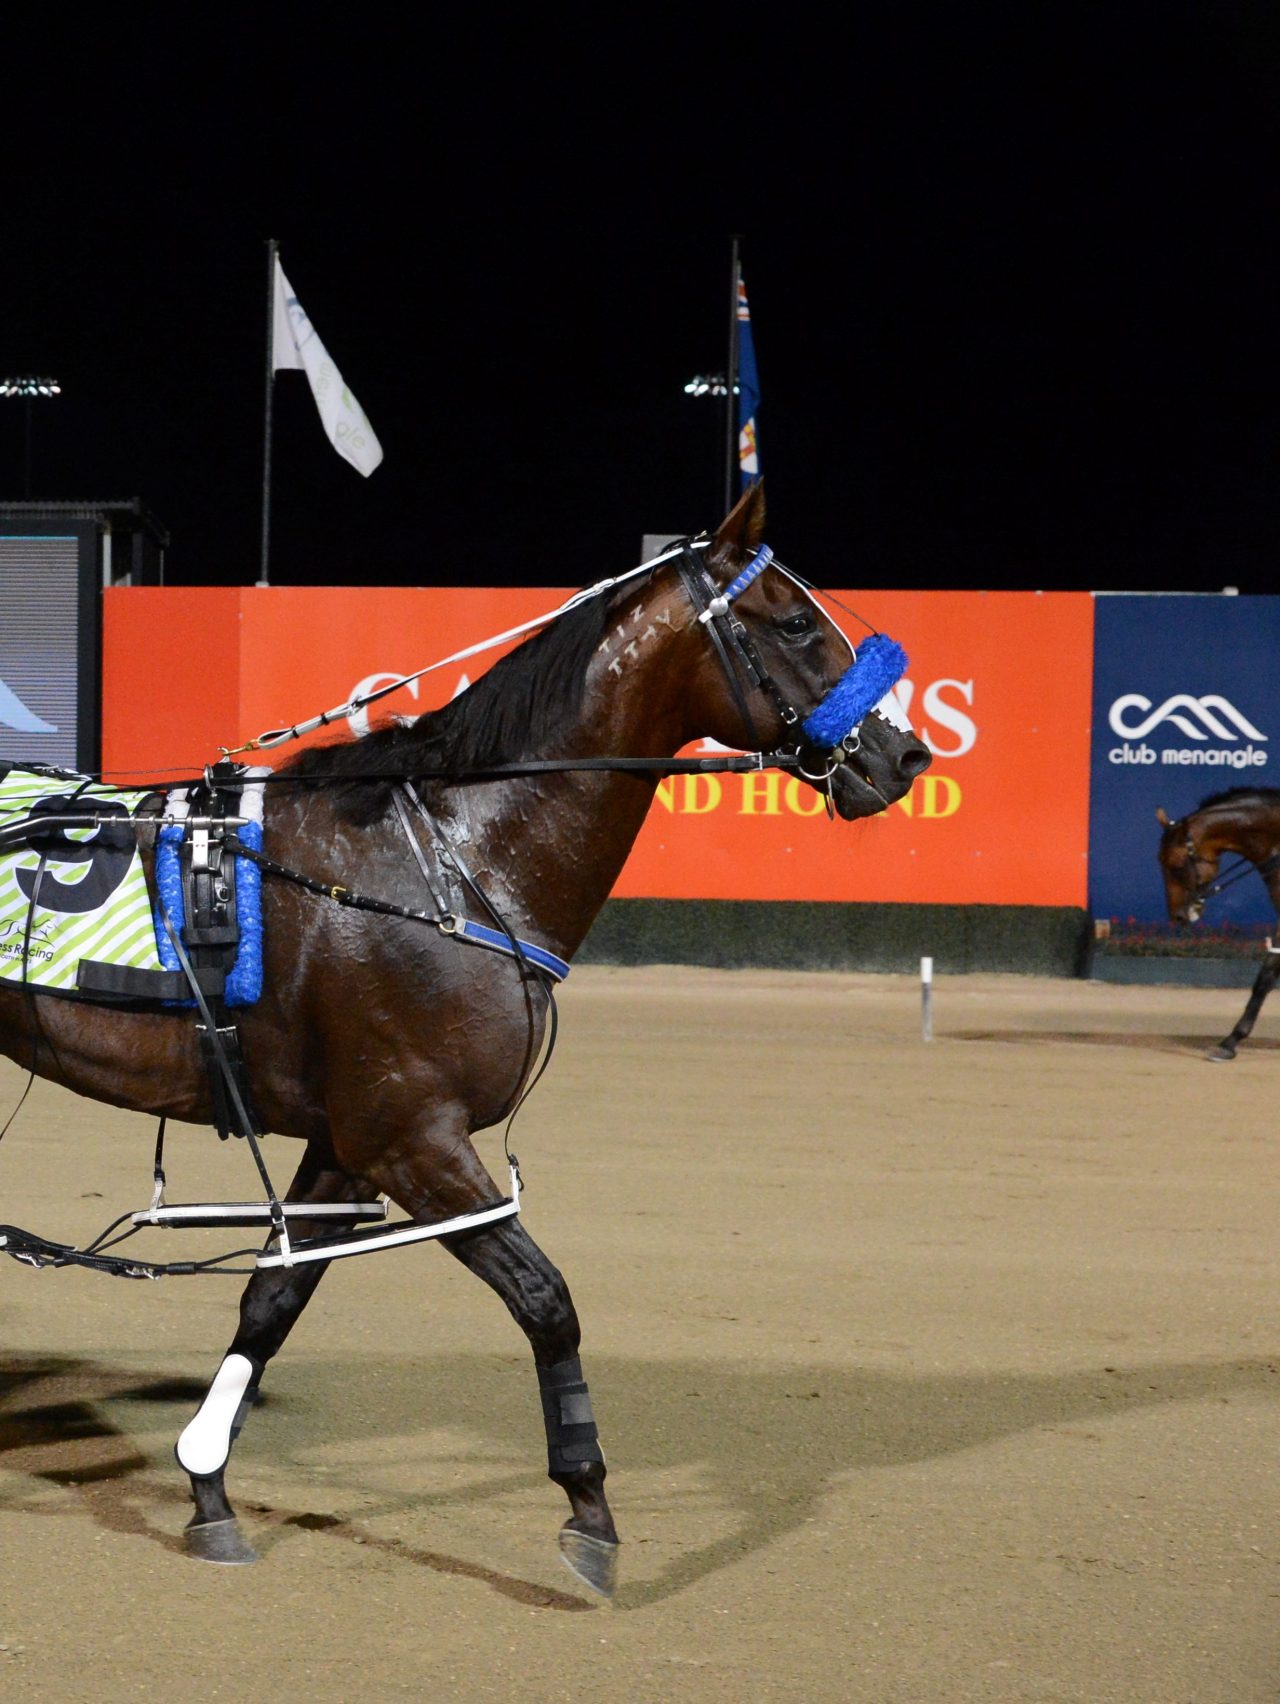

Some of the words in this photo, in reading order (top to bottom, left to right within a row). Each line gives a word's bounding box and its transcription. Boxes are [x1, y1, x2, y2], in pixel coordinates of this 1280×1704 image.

[1109, 743, 1157, 764] club
[1162, 744, 1268, 769] menangle
[654, 773, 723, 814] ND
